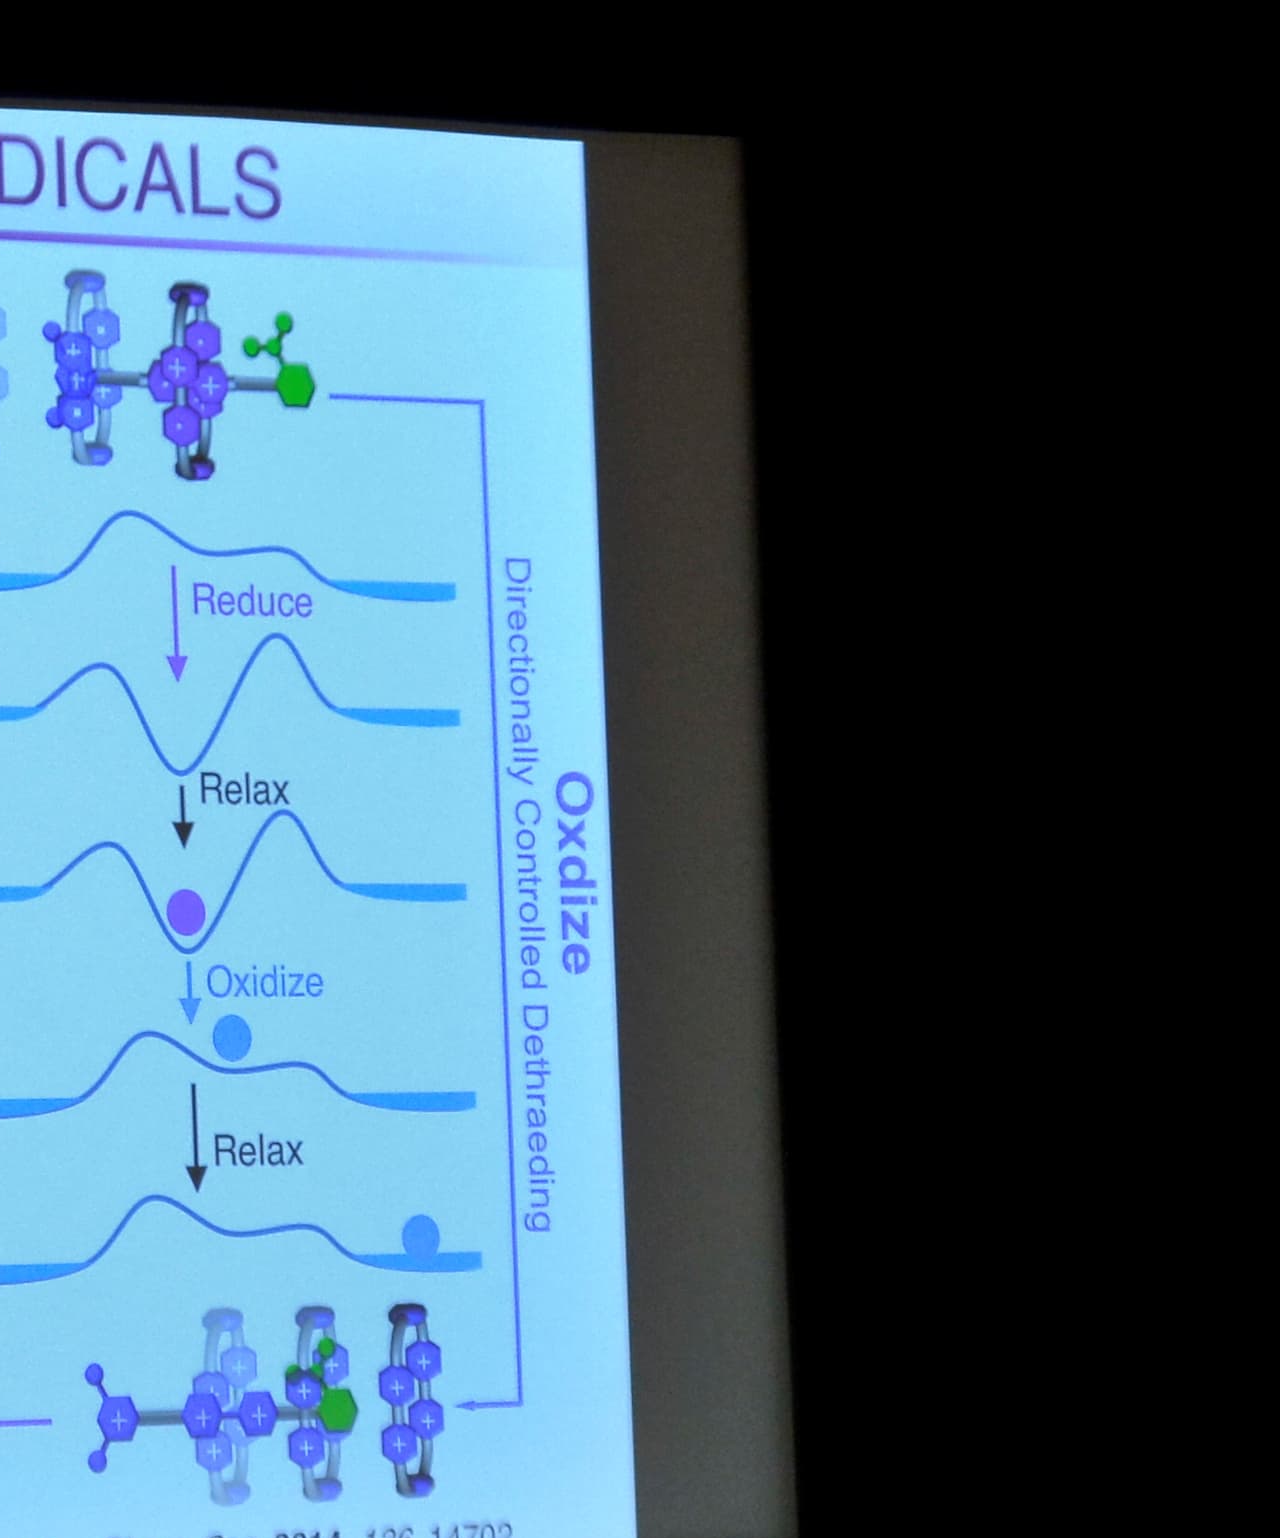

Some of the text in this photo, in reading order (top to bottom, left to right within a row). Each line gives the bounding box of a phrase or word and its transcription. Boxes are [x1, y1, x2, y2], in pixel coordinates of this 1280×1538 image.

[192, 581, 314, 619] Reduce
[200, 771, 290, 806] Relax
[554, 771, 598, 976] Oxdize
[504, 557, 556, 1234] Directionally Controlled Dethraeding
[206, 964, 324, 999] Oxidize
[214, 1133, 304, 1167] Relax
